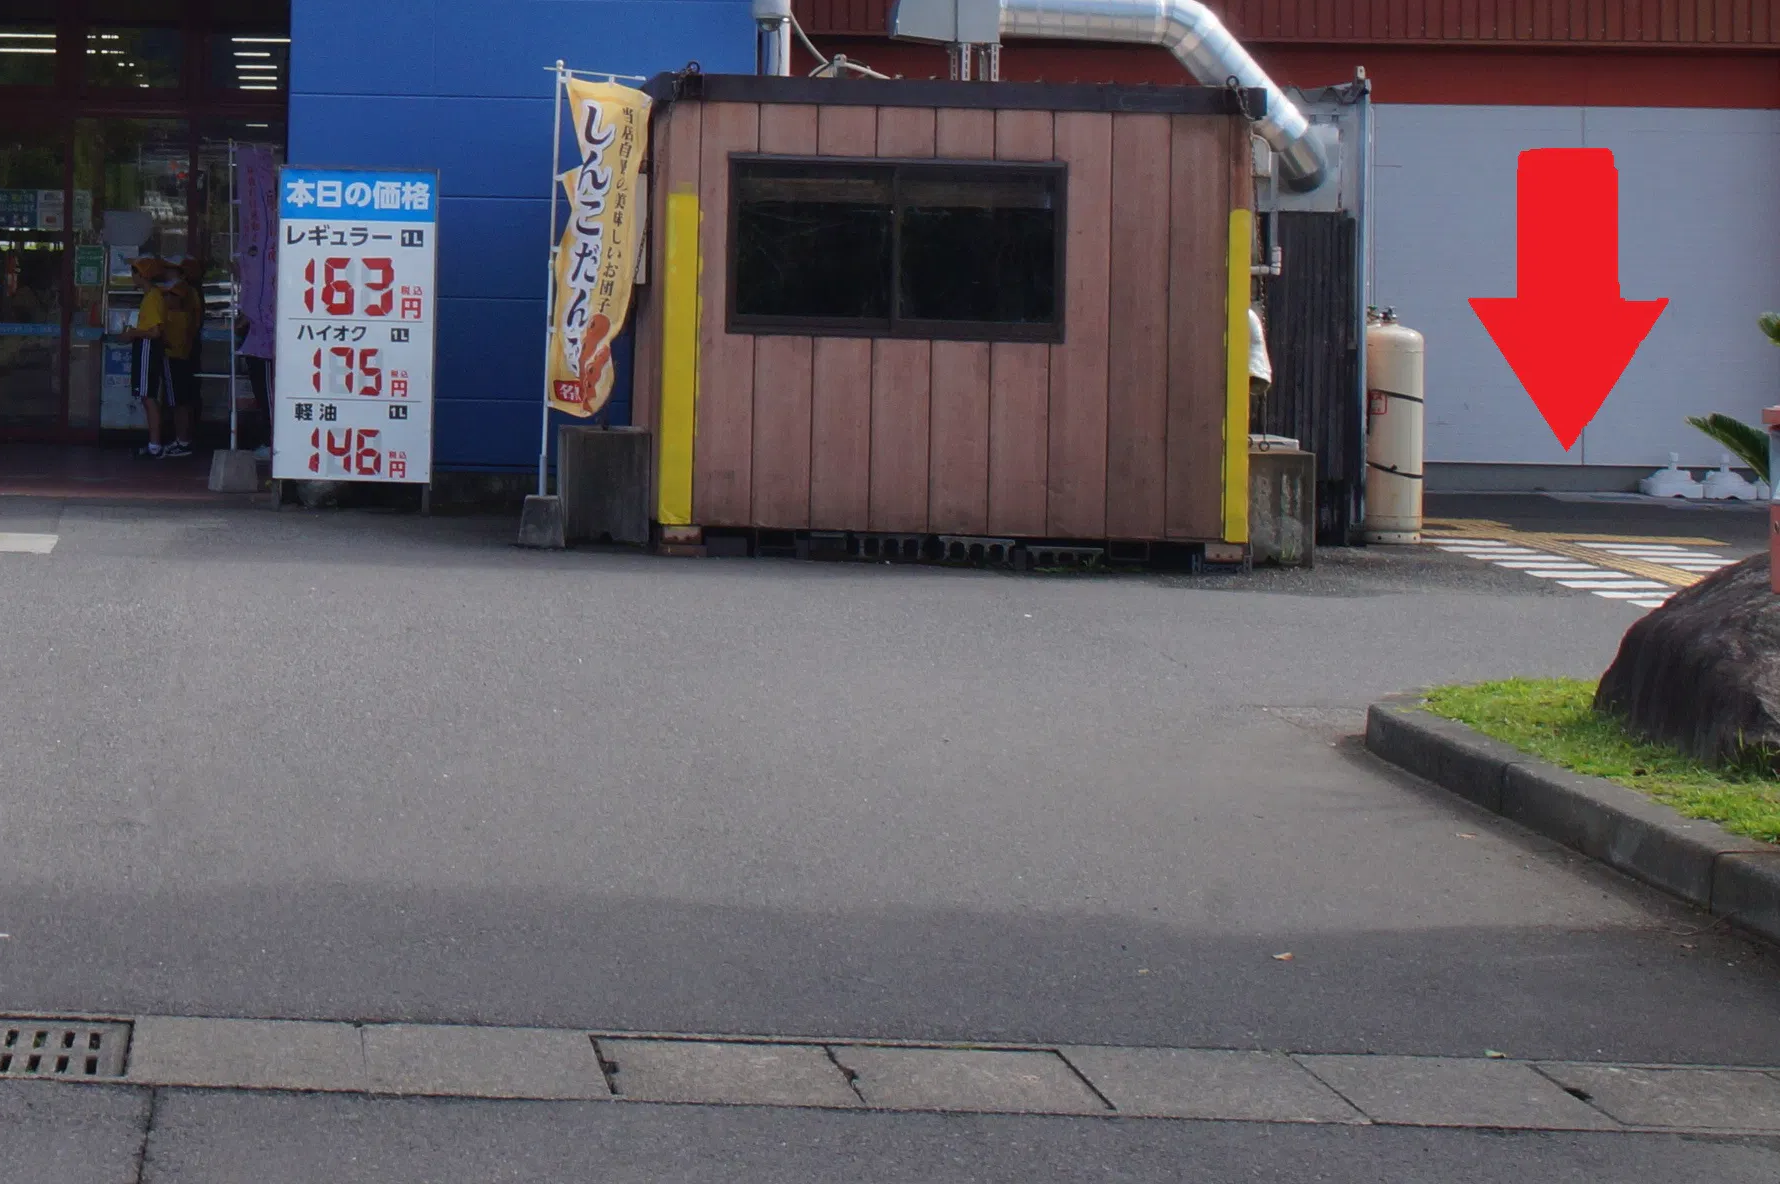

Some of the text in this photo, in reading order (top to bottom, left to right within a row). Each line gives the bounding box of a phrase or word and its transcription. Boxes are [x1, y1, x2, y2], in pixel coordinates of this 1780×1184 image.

[286, 179, 430, 210] 本日の価格
[287, 225, 423, 246] レギュラー 1L
[304, 257, 394, 316] 163
[401, 286, 422, 296] 税込
[401, 298, 422, 319] 円
[297, 325, 409, 342] ハイオク 1L
[312, 347, 382, 396] 175
[391, 380, 408, 397] 円
[294, 403, 408, 422] 軽油 1L
[308, 427, 382, 476] 146
[389, 461, 406, 478] 円
